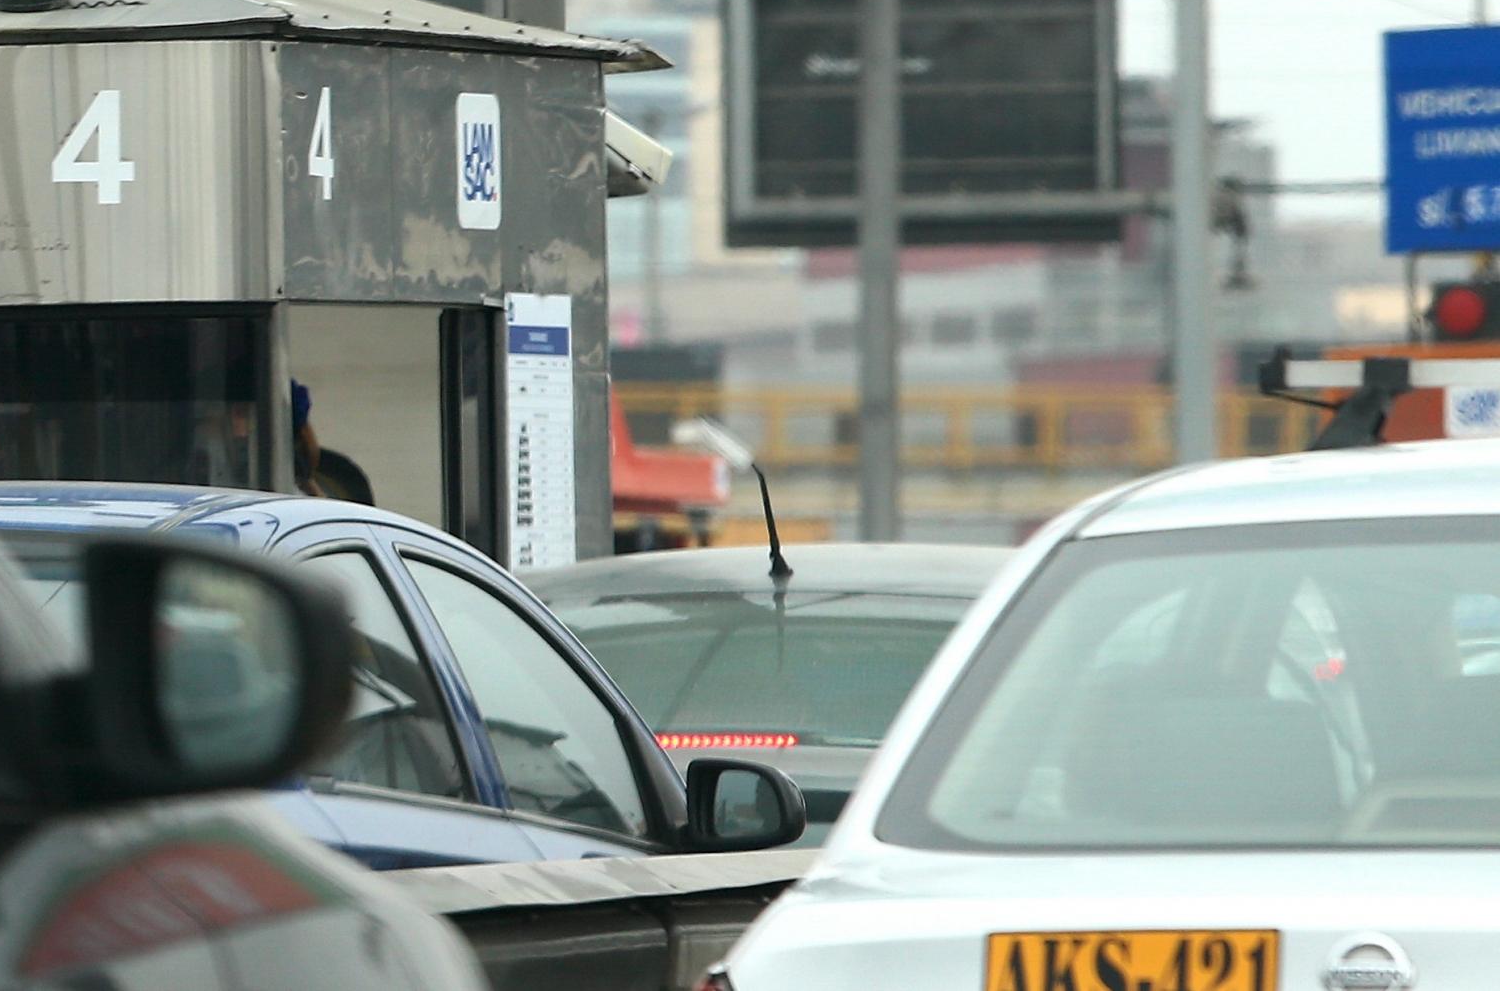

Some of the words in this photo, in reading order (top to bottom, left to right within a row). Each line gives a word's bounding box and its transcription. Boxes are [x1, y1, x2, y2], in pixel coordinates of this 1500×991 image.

[51, 89, 136, 205] 4
[308, 86, 335, 201] 4
[462, 122, 494, 166] LAM
[996, 938, 1268, 991] AKS-421
